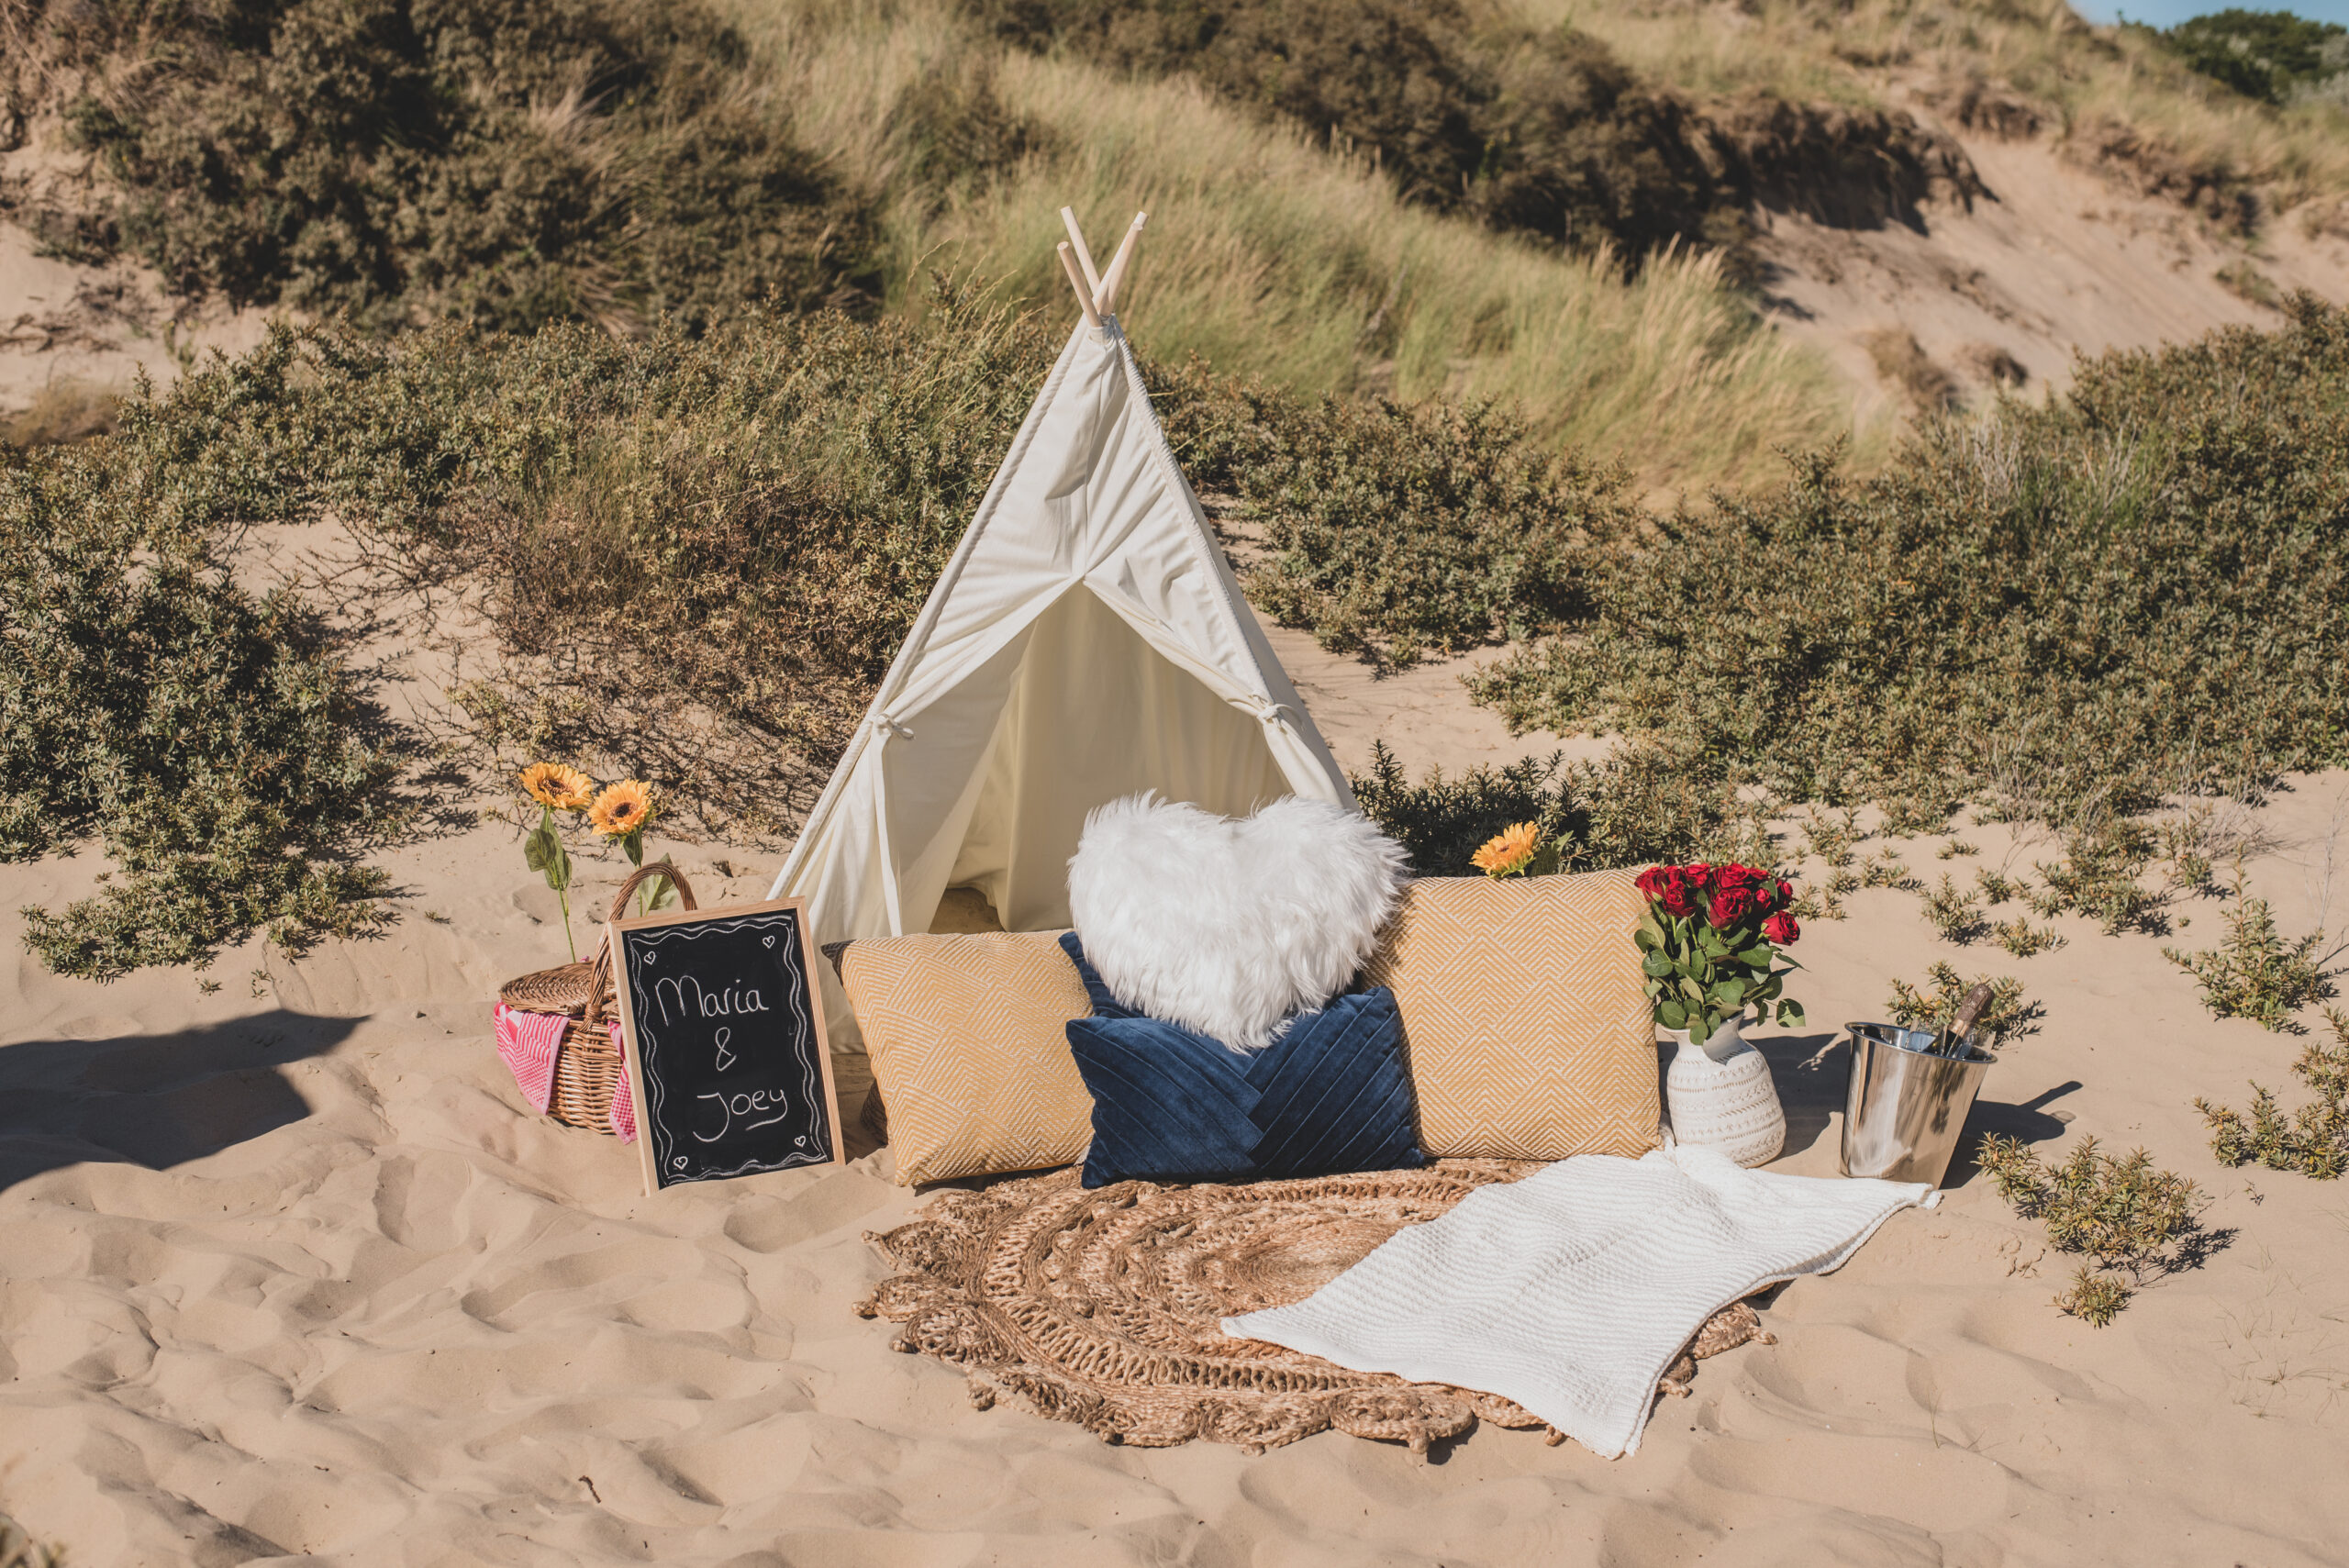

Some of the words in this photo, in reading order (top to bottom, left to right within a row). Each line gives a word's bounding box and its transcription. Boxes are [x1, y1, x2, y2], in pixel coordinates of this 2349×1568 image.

[654, 975, 769, 1027] Maria
[715, 1027, 737, 1072] &
[693, 1088, 788, 1142] Joey
